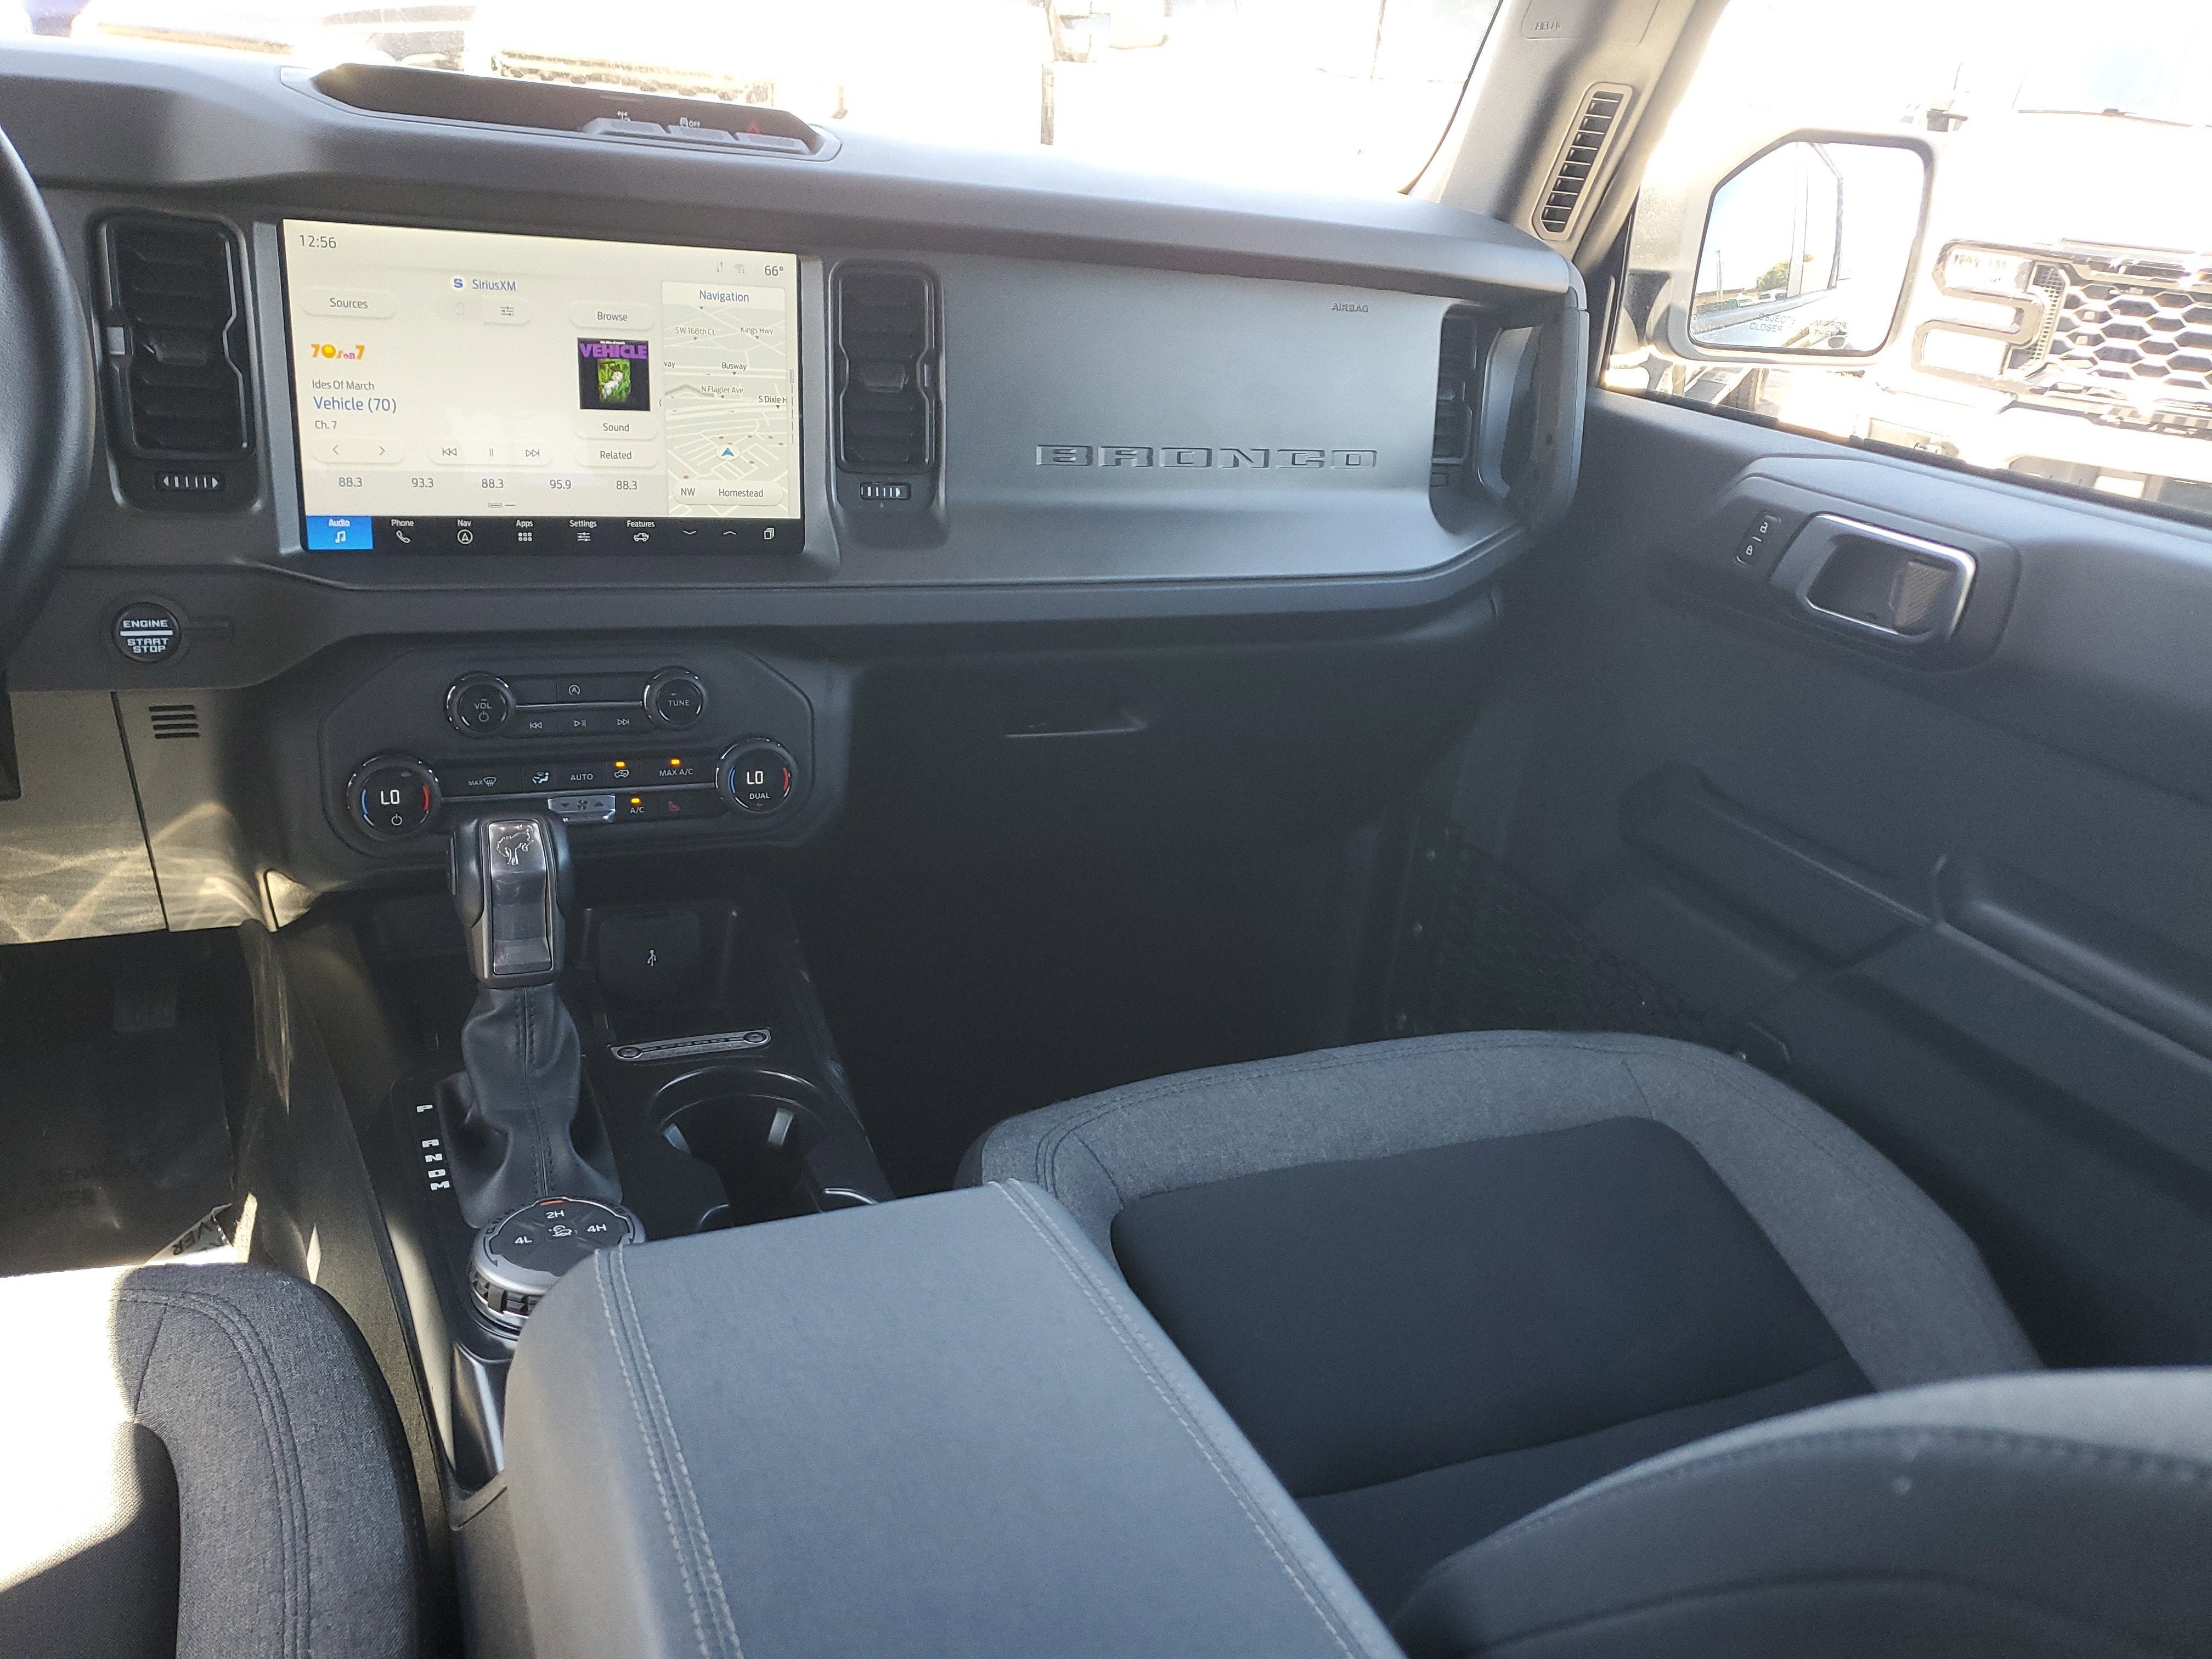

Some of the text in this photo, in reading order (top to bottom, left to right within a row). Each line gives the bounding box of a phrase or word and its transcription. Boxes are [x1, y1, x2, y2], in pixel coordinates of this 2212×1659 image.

[299, 234, 336, 249] 12:56
[764, 265, 783, 276] 66°
[472, 279, 516, 291] SiriusXM
[699, 290, 749, 302] Navigation
[329, 297, 368, 309] Sources
[597, 311, 628, 321] Browse
[741, 326, 758, 335] Kings
[579, 343, 647, 359] VEHICLE
[721, 362, 747, 371] Busway
[312, 379, 375, 390] Ides Of March
[708, 386, 730, 394] Flagler
[313, 397, 397, 414] Vehicle (70)
[315, 420, 337, 429] Ch. 7
[602, 422, 629, 432] Sound
[600, 450, 632, 460] Related
[1035, 445, 1378, 469] BRONCO
[338, 477, 363, 487] 88.3
[411, 478, 434, 488] 93.3
[481, 478, 504, 489] 88.3
[550, 479, 572, 489] 95.9
[616, 480, 637, 490] 88.3
[681, 488, 696, 496] NW
[719, 488, 764, 498] Homestead
[329, 518, 351, 527] Audio
[391, 518, 414, 527] Phone
[516, 519, 533, 528] Apps
[569, 520, 597, 528] Settings
[123, 619, 168, 628] ENGINE
[127, 637, 169, 646] START
[133, 645, 166, 653] STOP
[668, 699, 690, 707] TUNE
[679, 768, 693, 776] A/C
[570, 773, 594, 781] AUTO
[746, 771, 764, 785] LO
[380, 789, 400, 805] LO
[416, 1104, 433, 1113] P
[425, 1153, 443, 1163] N
[428, 1169, 446, 1178] D
[430, 1181, 450, 1190] M
[545, 1210, 565, 1219] 2H
[587, 1224, 607, 1233] 4H
[514, 1236, 533, 1245] 4L
